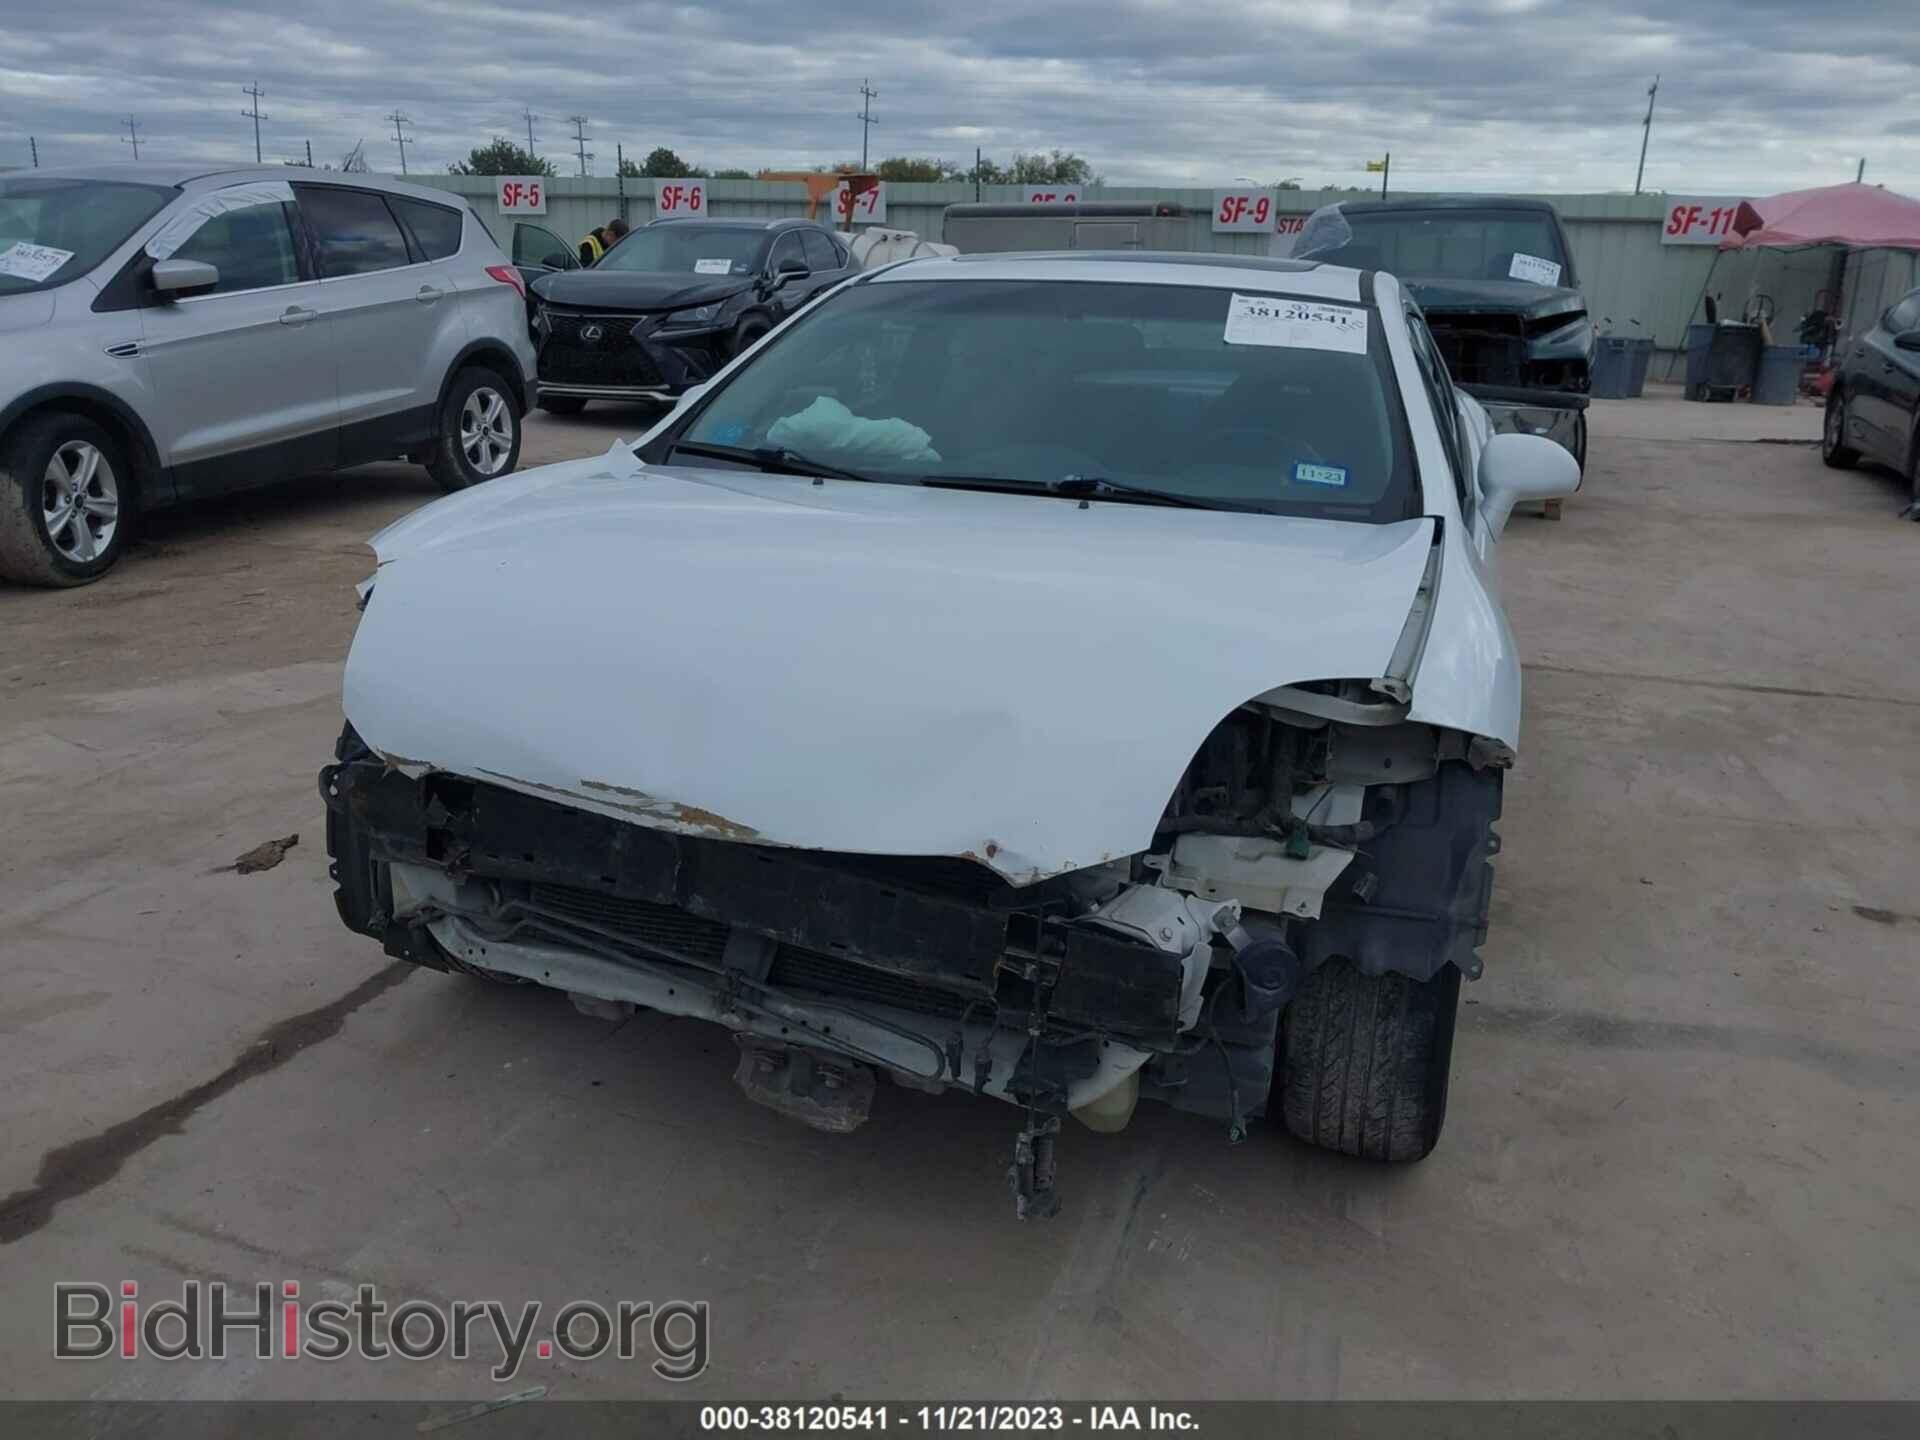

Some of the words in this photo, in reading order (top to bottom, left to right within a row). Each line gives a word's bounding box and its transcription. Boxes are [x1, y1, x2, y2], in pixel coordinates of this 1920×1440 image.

[502, 183, 540, 208] SF-5
[661, 186, 701, 211] SF-6
[838, 189, 879, 214] S-7
[1219, 196, 1270, 224] SF-9
[1666, 205, 1734, 235] SF-11
[1244, 305, 1348, 326] 38120541
